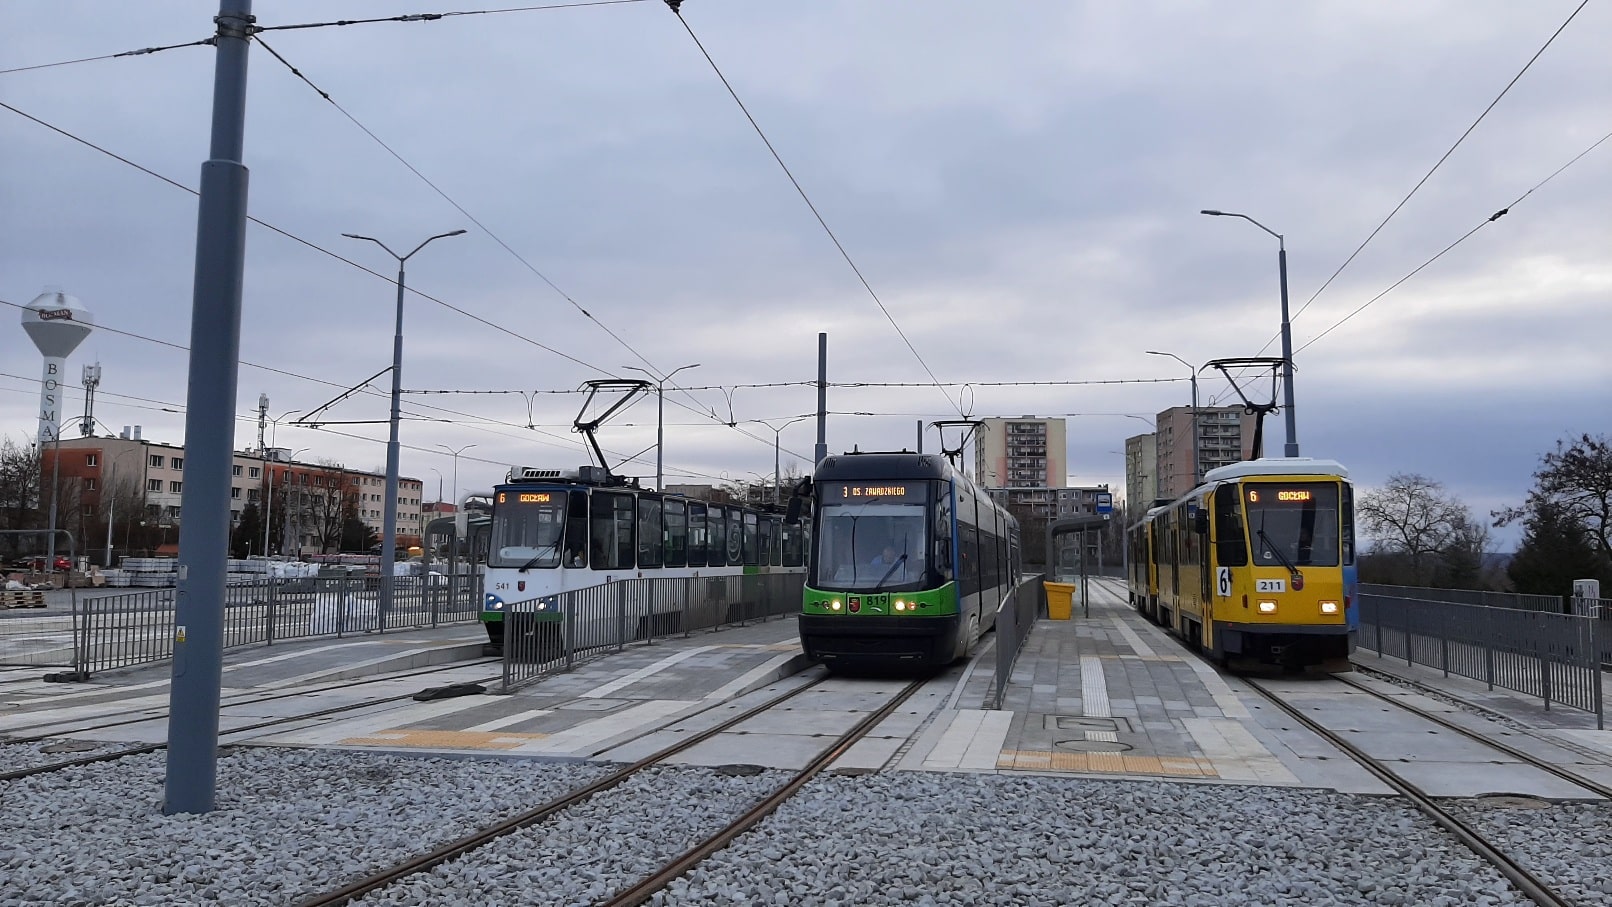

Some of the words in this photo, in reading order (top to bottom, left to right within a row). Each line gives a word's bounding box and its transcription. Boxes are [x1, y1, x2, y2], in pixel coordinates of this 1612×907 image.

[843, 486, 848, 498] 3
[852, 487, 863, 496] OS.
[1250, 490, 1257, 502] 6
[499, 493, 505, 503] 6
[1220, 568, 1228, 593] 6
[1260, 581, 1281, 590] 211
[495, 582, 509, 590] 541
[866, 595, 887, 605] 819
